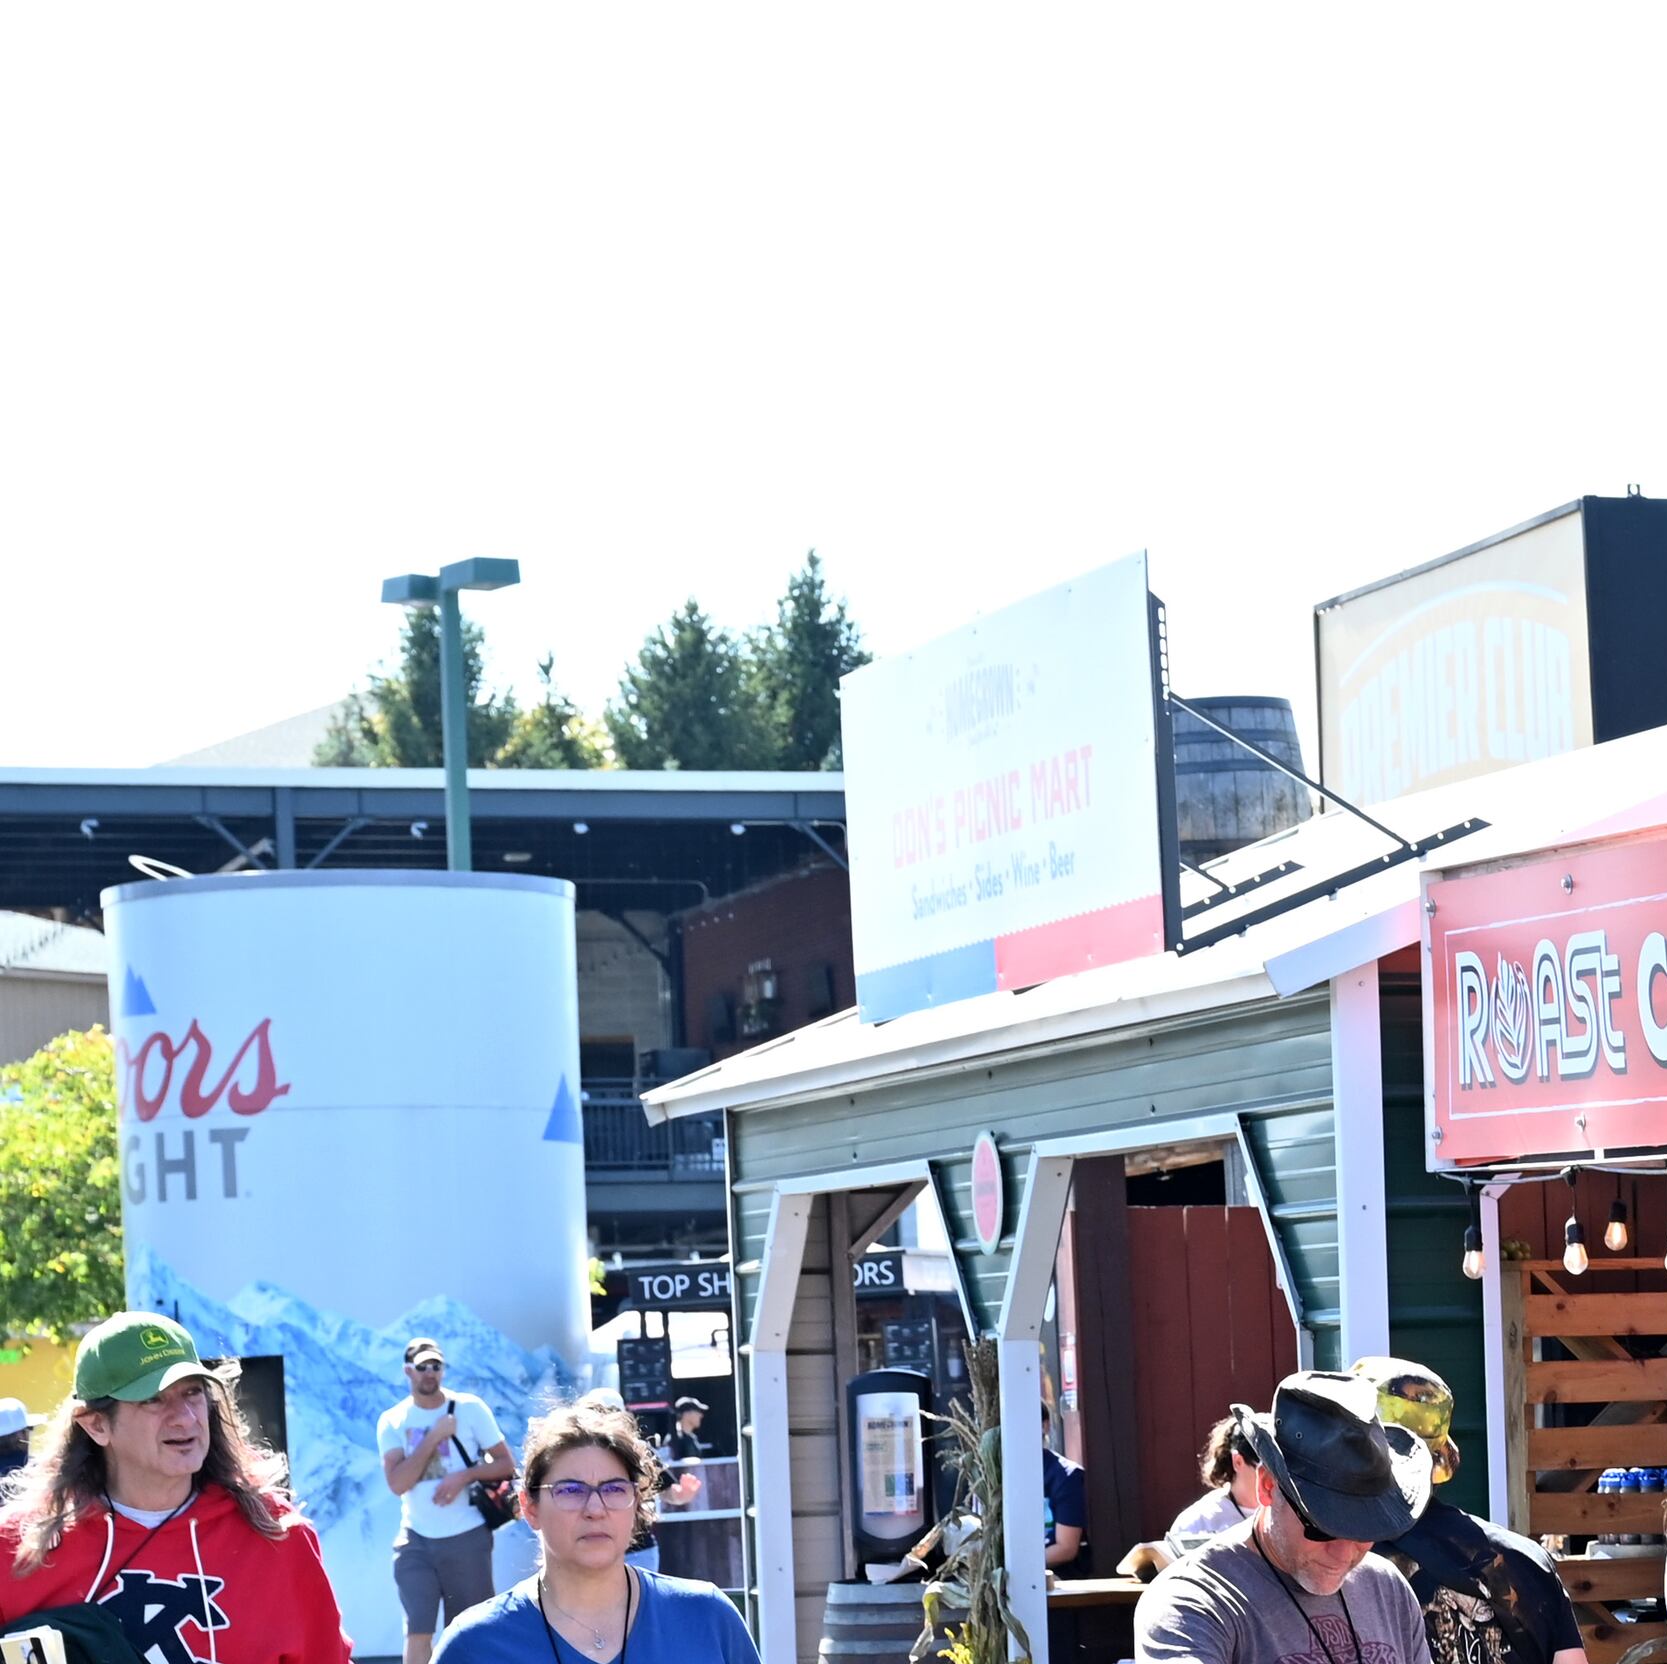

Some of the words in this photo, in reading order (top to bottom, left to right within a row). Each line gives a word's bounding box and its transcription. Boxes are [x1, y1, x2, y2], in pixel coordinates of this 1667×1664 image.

[1340, 619, 1480, 806] PREMIER
[953, 768, 1022, 849] PICNIC
[1030, 743, 1094, 825] MART
[911, 871, 967, 921] Sandwiches
[974, 860, 1004, 902] Sides
[1011, 849, 1041, 889] Wine
[1049, 839, 1076, 881] Beer
[638, 1275, 690, 1300] TOP
